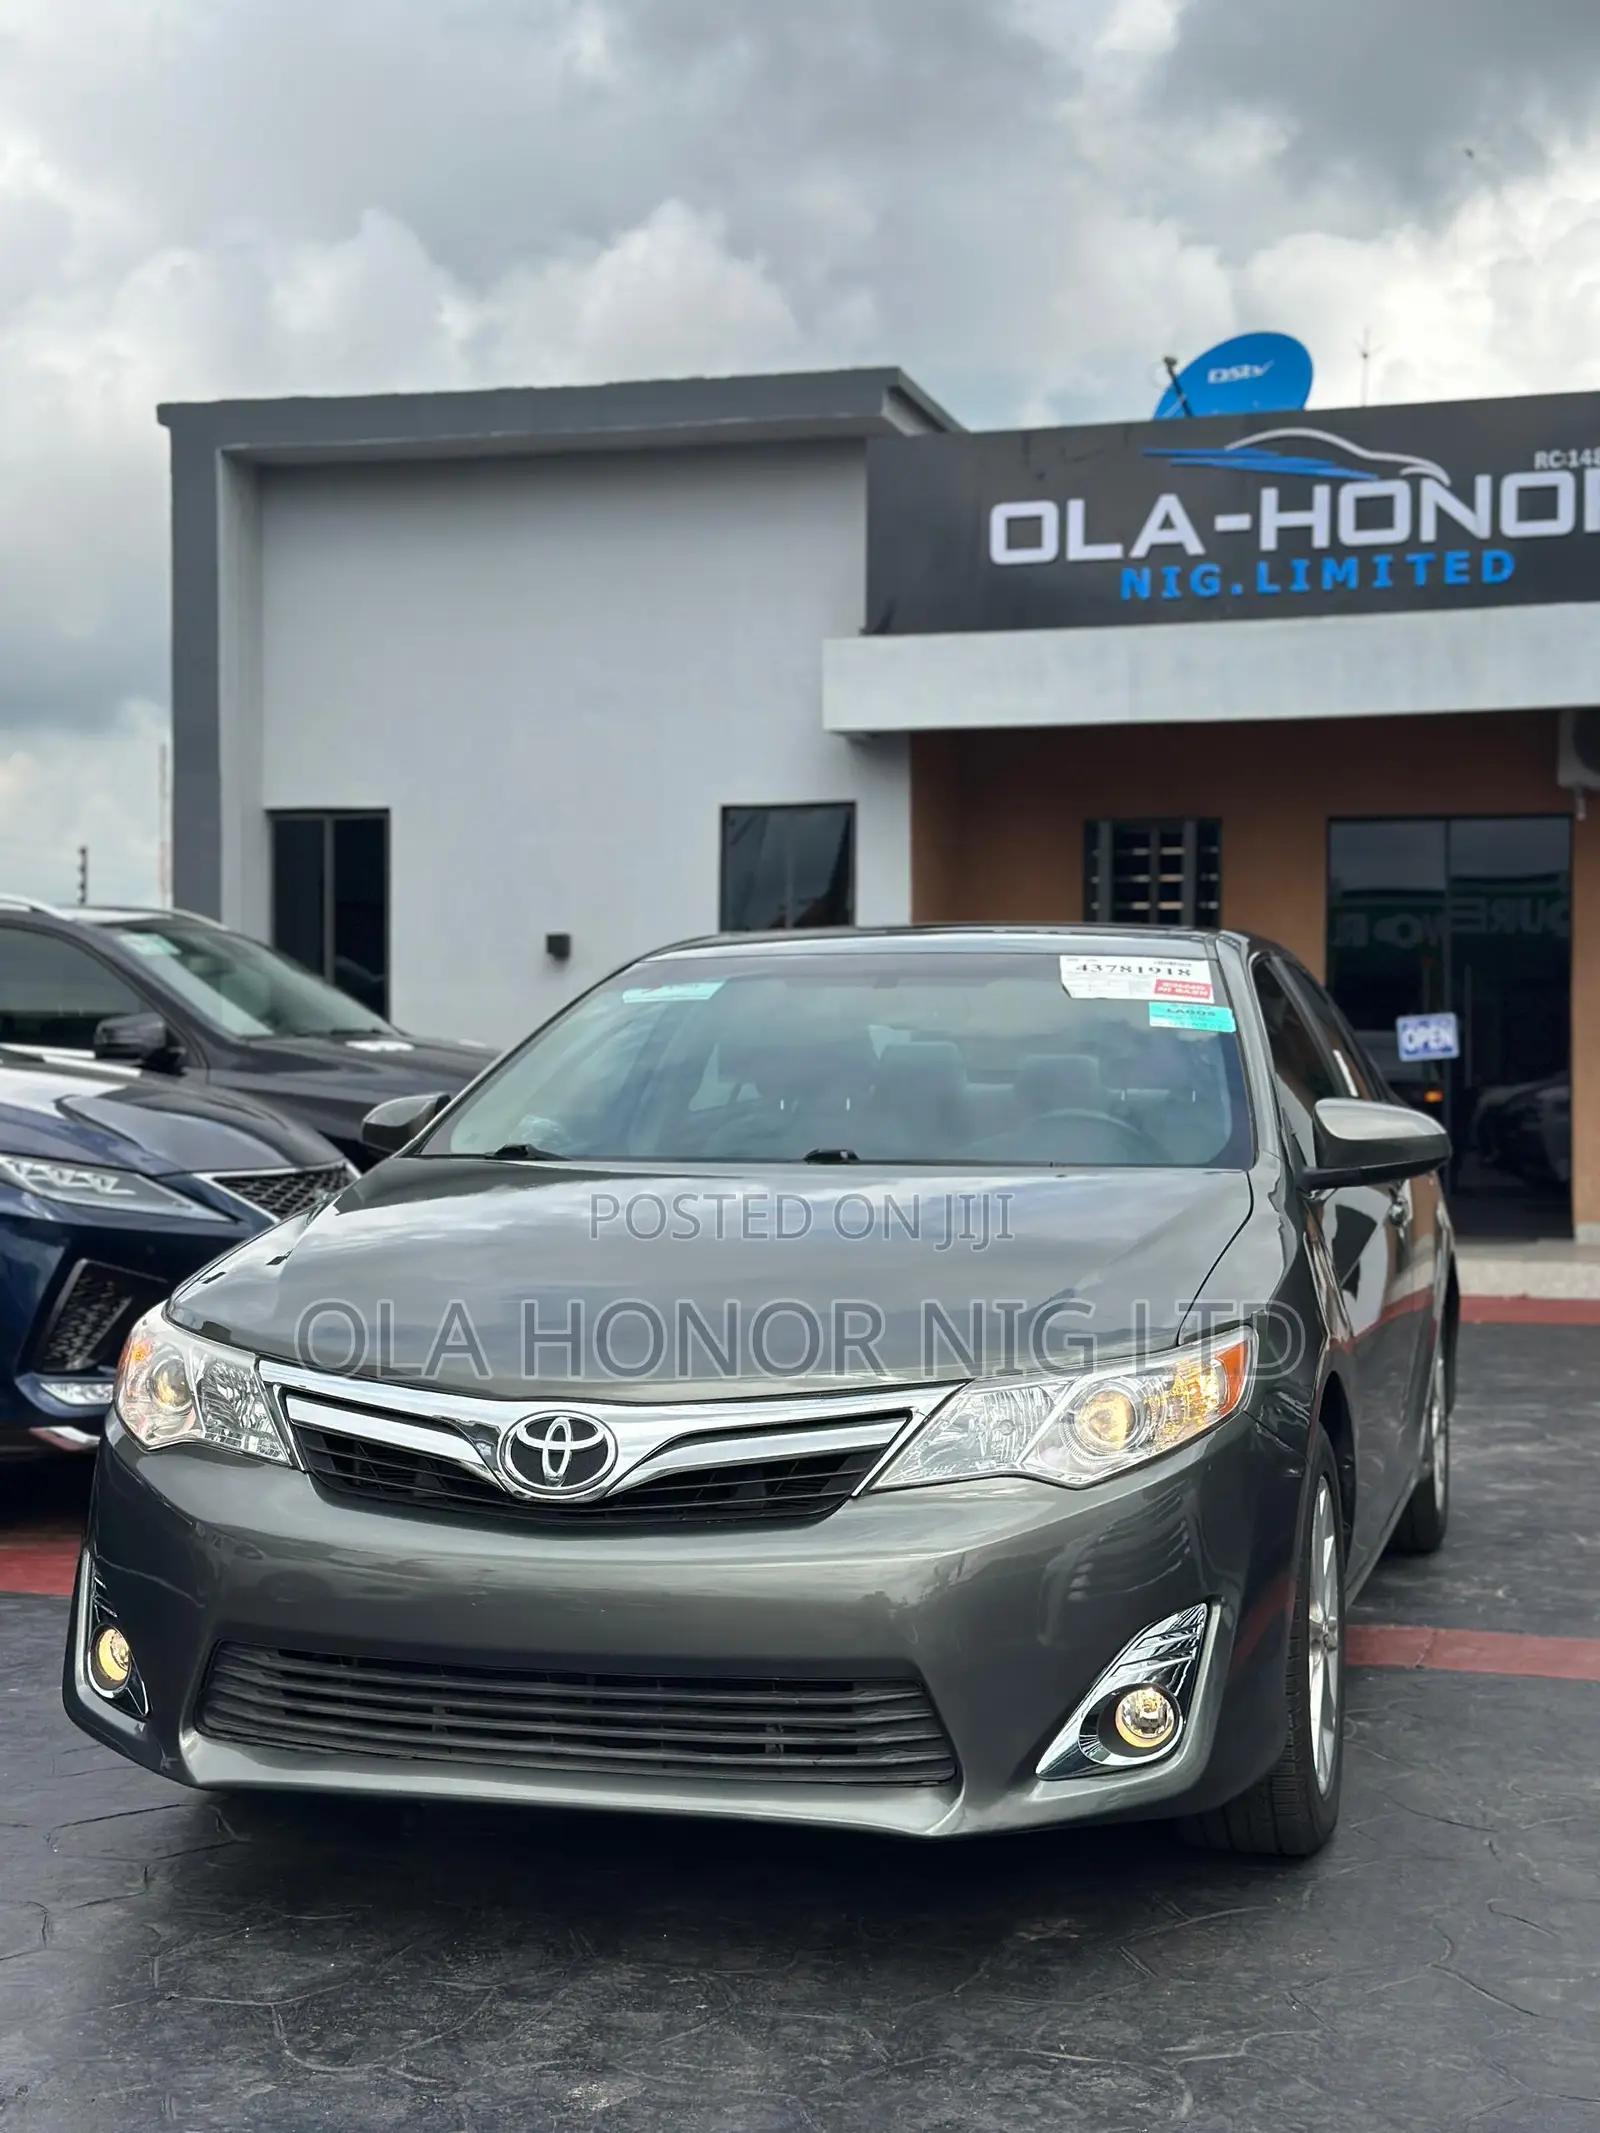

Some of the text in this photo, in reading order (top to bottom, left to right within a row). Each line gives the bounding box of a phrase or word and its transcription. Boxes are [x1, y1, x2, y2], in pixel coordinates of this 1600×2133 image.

[989, 467, 1600, 565] OLA-HONO
[1076, 963, 1191, 976] 43781918
[1402, 1026, 1452, 1051] OPEN
